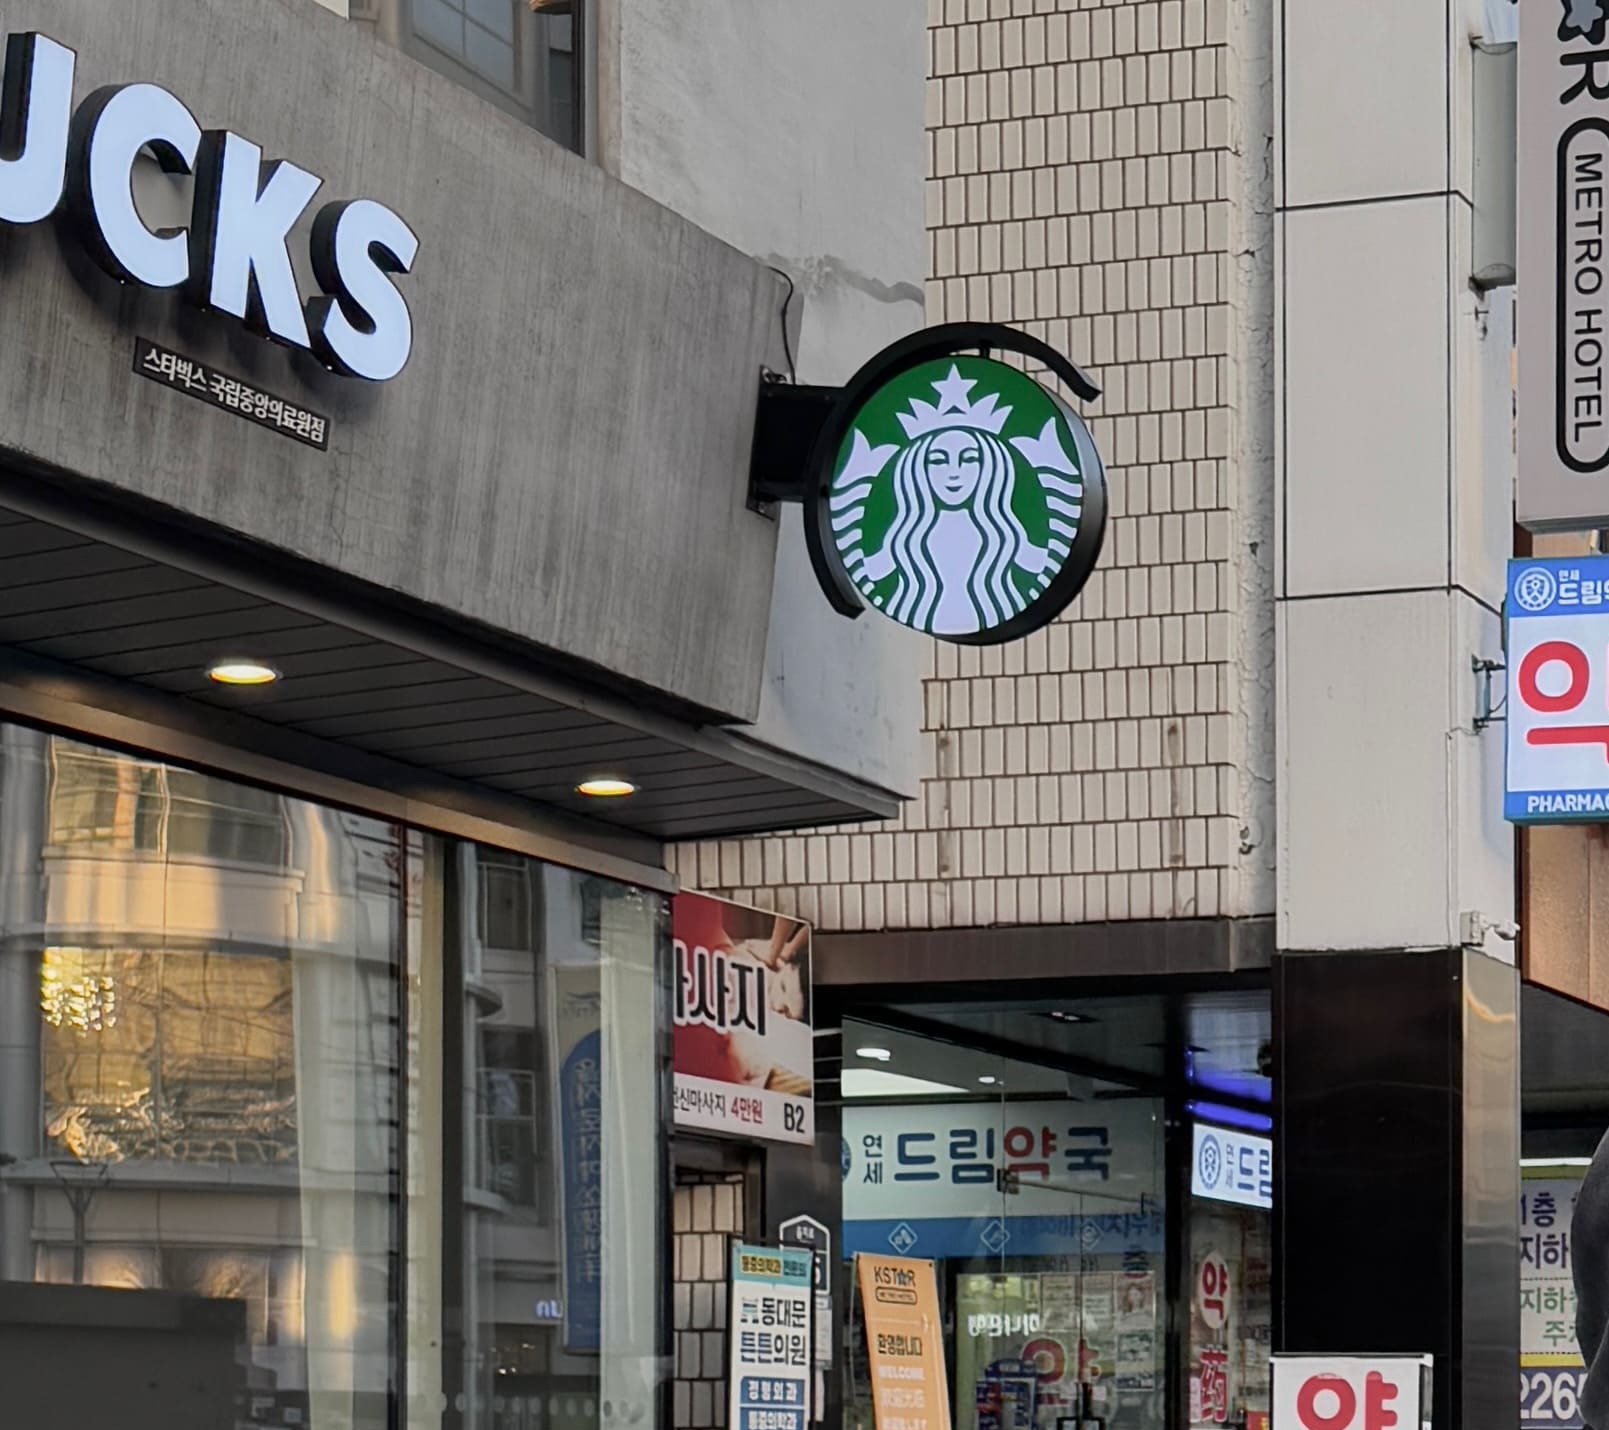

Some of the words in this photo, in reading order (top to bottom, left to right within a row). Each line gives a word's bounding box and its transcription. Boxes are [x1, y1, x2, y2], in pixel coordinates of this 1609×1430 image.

[1574, 153, 1604, 296] METRO
[143, 347, 207, 393] 스타벅스
[208, 374, 326, 443] 국립중앙의료원점
[1574, 309, 1604, 443] HOTEL
[730, 1095, 764, 1124] 4만원
[783, 1102, 806, 1134] B2
[893, 1125, 1114, 1186] 드림약국
[761, 1297, 807, 1329] 동대문
[1202, 1261, 1229, 1321] 약
[740, 1331, 807, 1366] 튼튼의원
